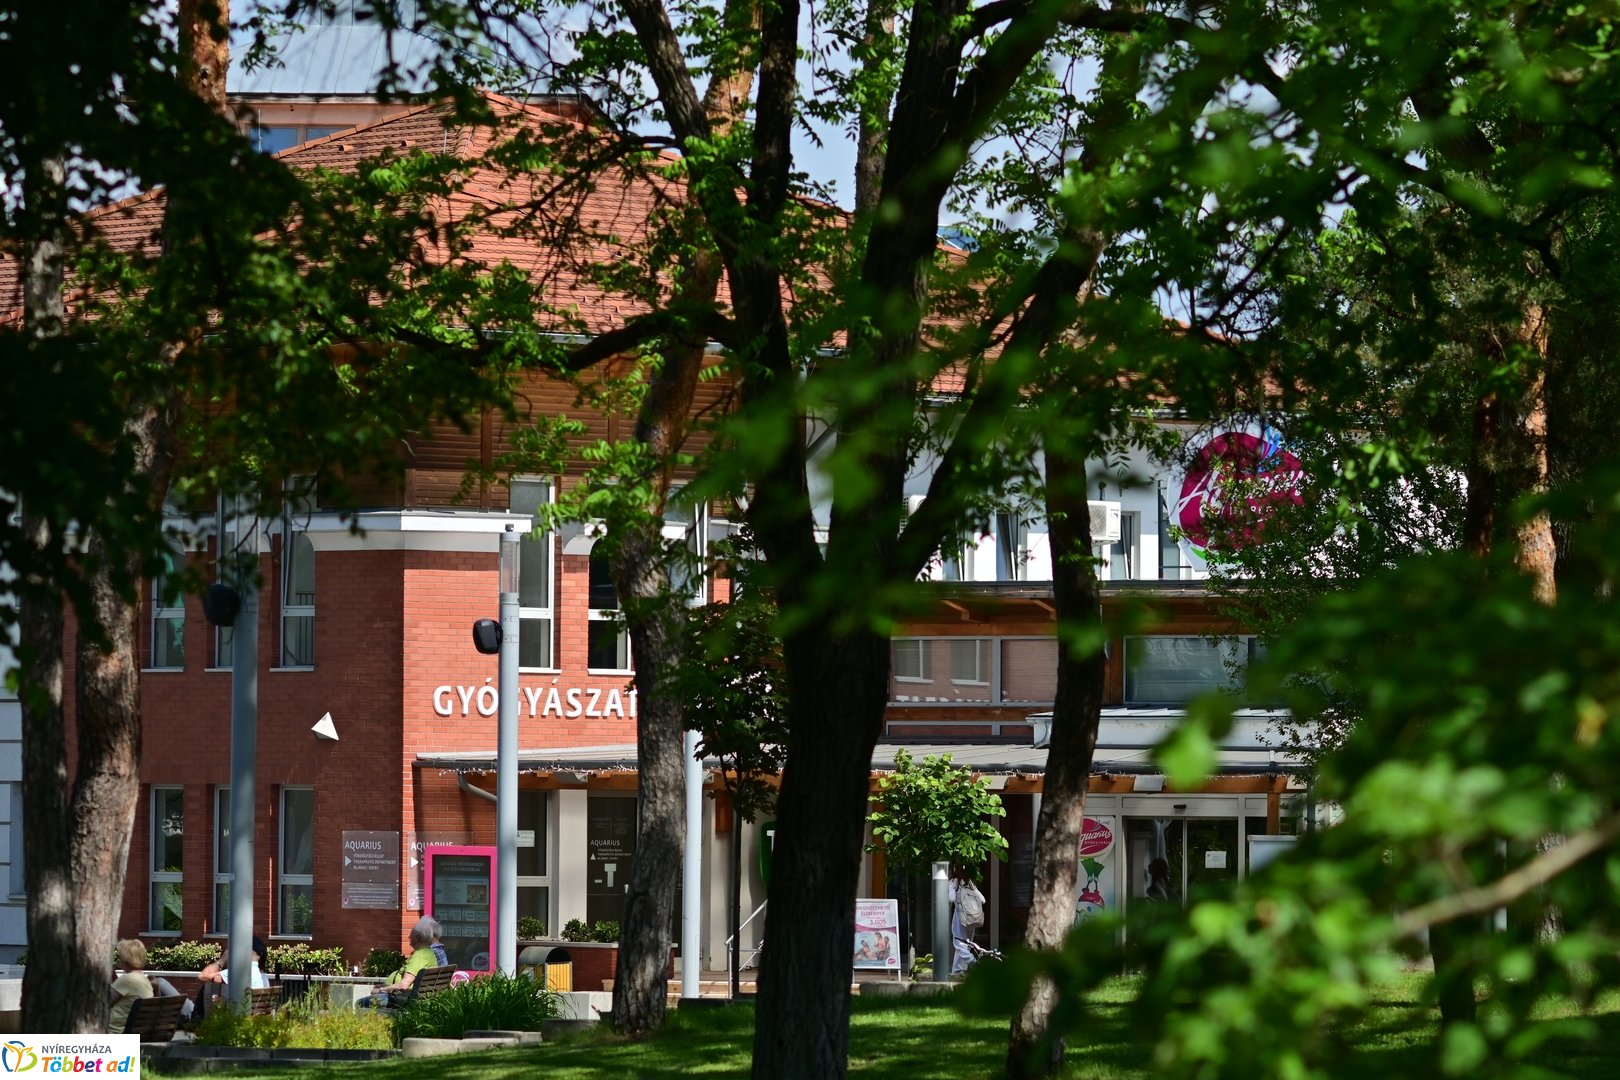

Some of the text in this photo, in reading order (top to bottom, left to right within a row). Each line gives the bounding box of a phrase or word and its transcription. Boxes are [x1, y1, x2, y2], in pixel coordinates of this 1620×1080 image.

[432, 677, 638, 718] GYÓYÁSZAT
[1079, 830, 1112, 842] quarius
[344, 841, 382, 851] AQUARIUS
[590, 839, 621, 847] AQUARIUS
